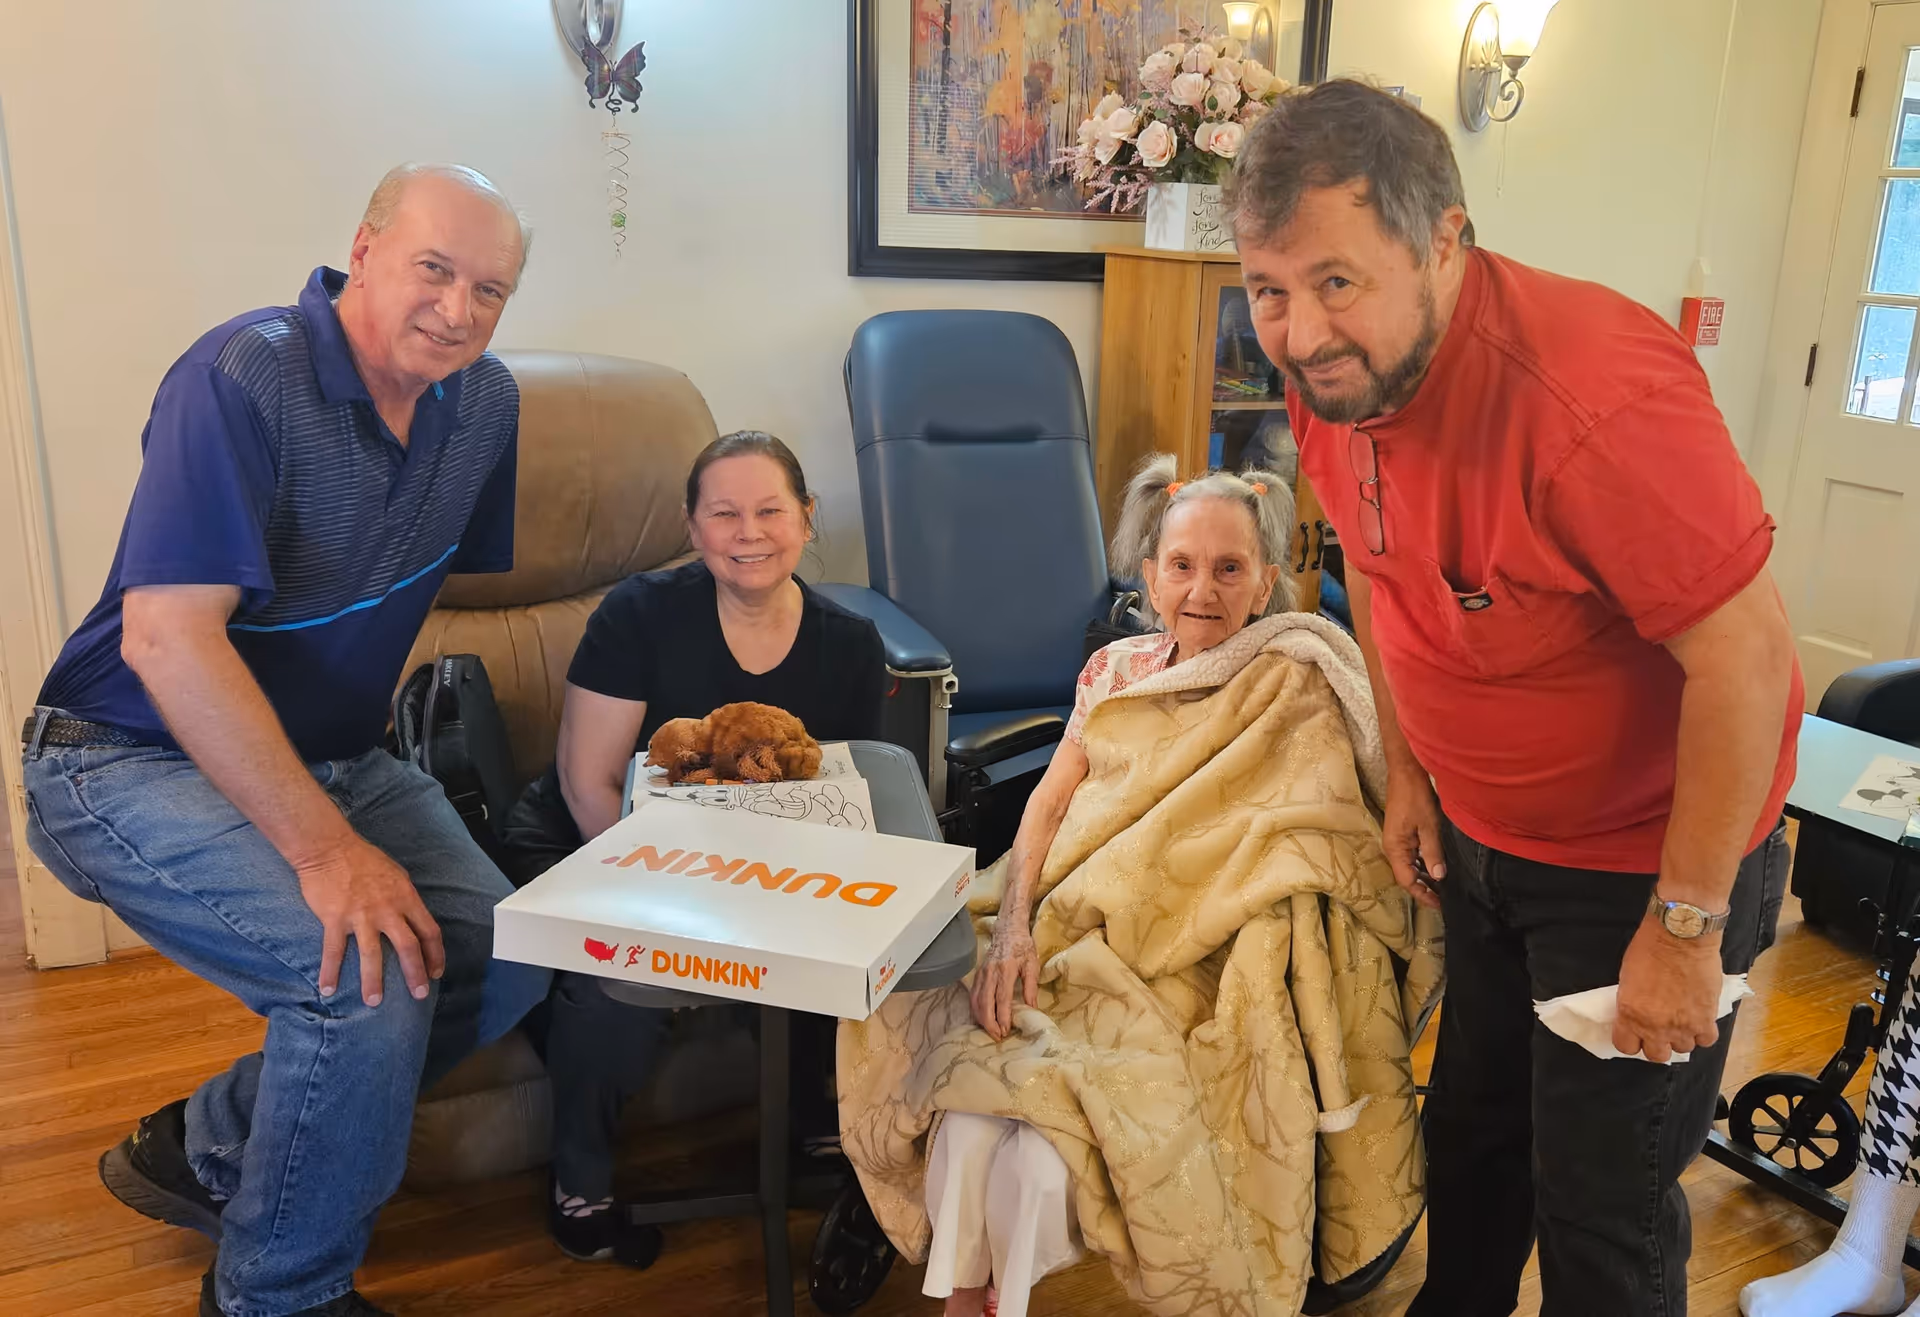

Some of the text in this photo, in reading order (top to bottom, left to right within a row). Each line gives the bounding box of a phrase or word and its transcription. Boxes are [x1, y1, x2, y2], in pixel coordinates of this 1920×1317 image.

[1192, 217, 1219, 234] Love
[1195, 231, 1230, 250] Kind
[1701, 306, 1723, 324] FIRE
[601, 845, 898, 907] DUNKIN'
[651, 949, 768, 990] DUNKIN'
